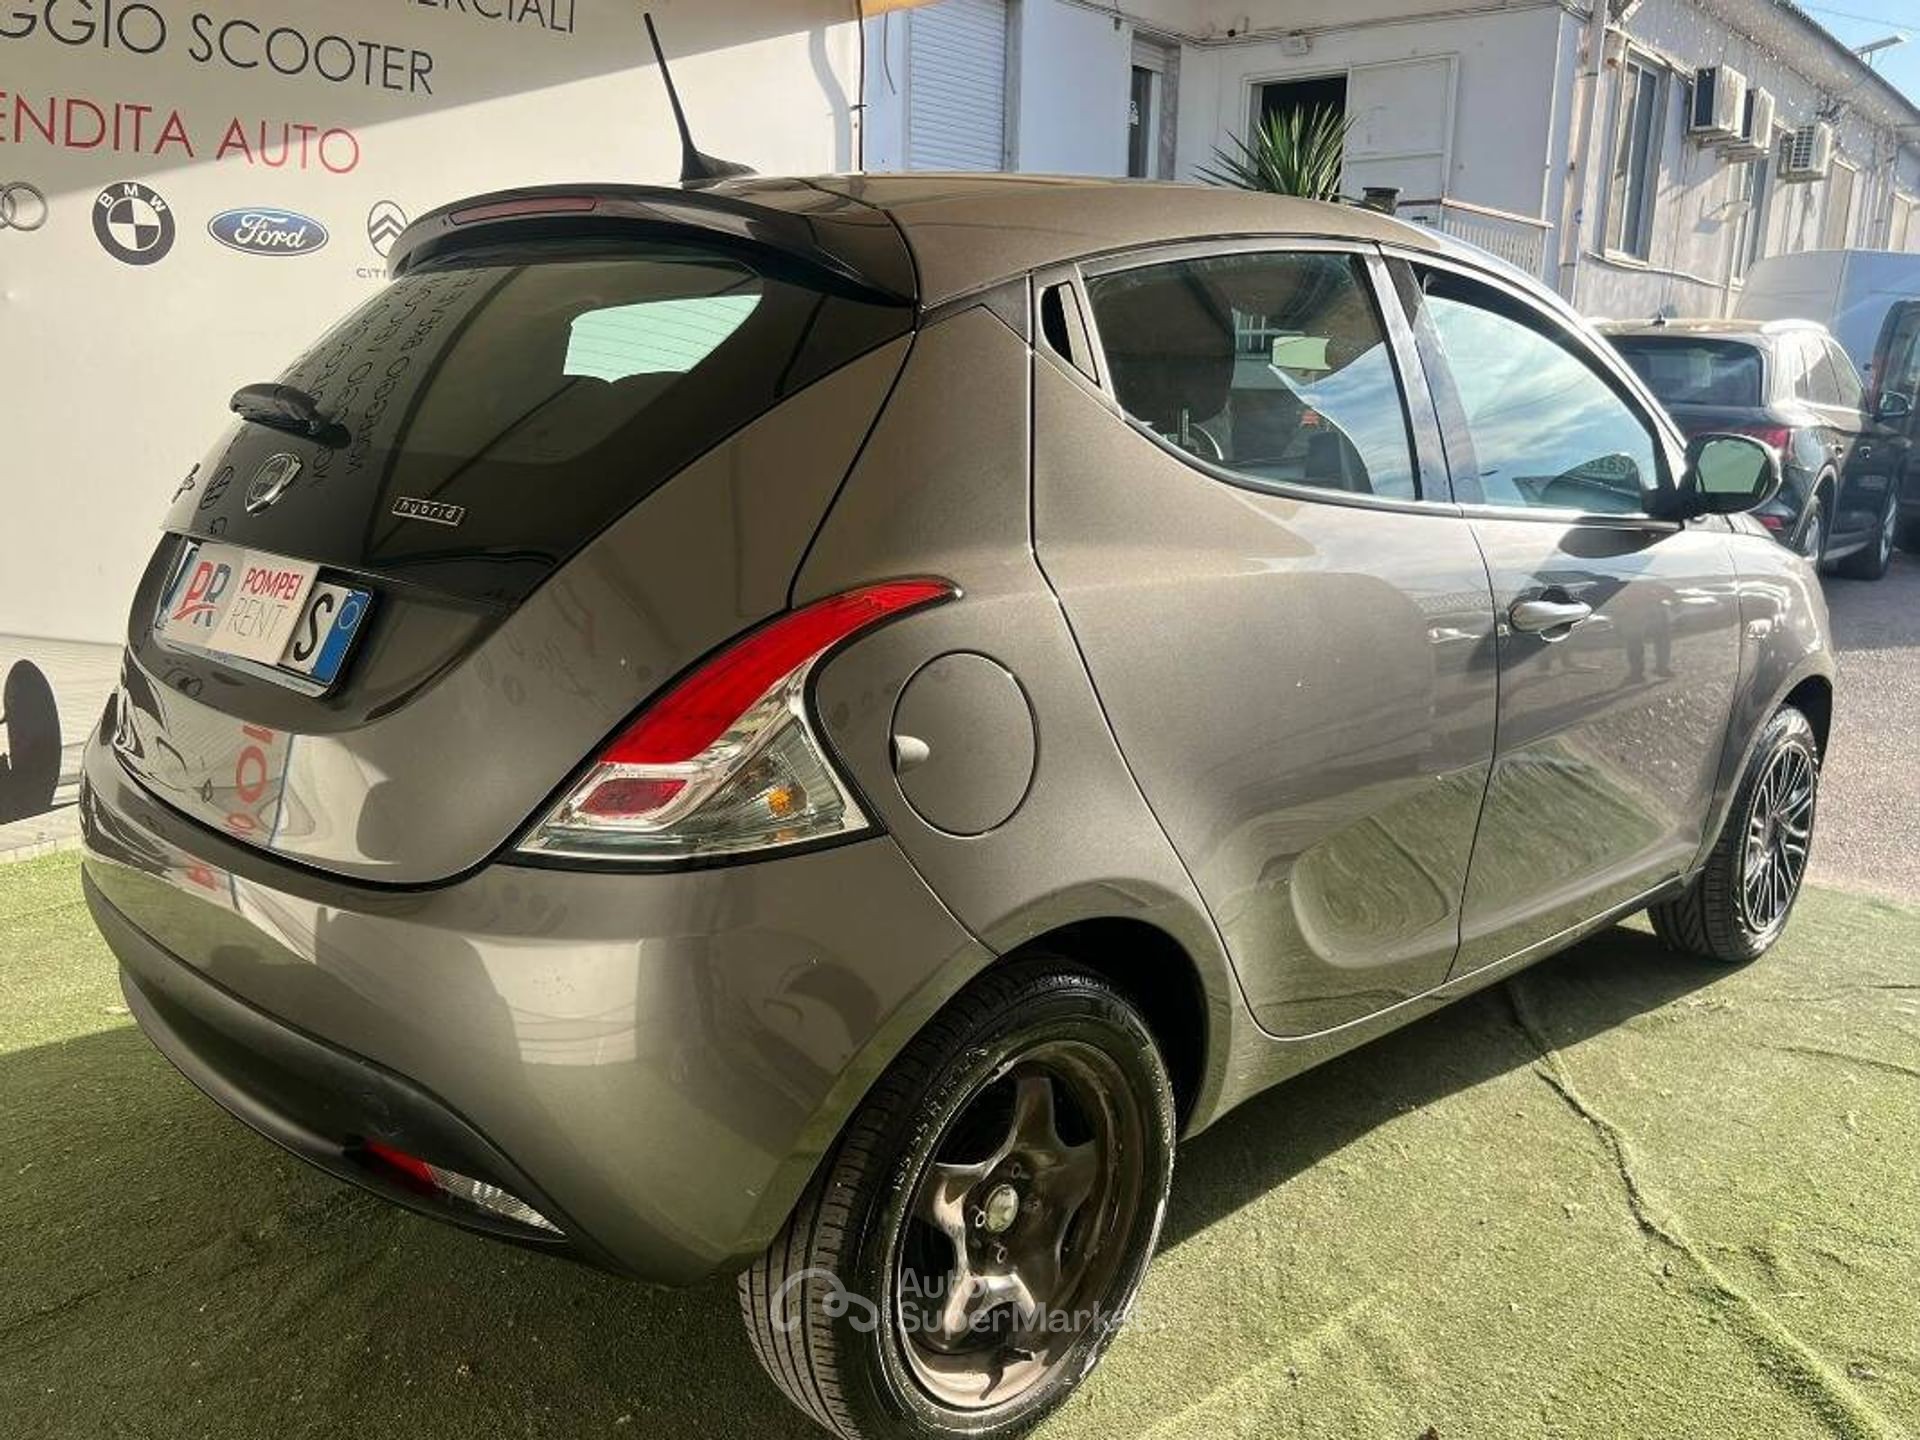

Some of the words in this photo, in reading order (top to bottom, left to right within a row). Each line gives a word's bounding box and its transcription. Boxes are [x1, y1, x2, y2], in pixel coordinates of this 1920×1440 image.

[187, 13, 434, 95] SCOOTER
[215, 116, 360, 174] AUTO
[98, 183, 167, 213] BMW
[233, 213, 307, 249] Ford
[399, 501, 458, 519] hybrid
[240, 567, 304, 601] POMPEI
[226, 596, 289, 641] RENT
[292, 592, 335, 662] S
